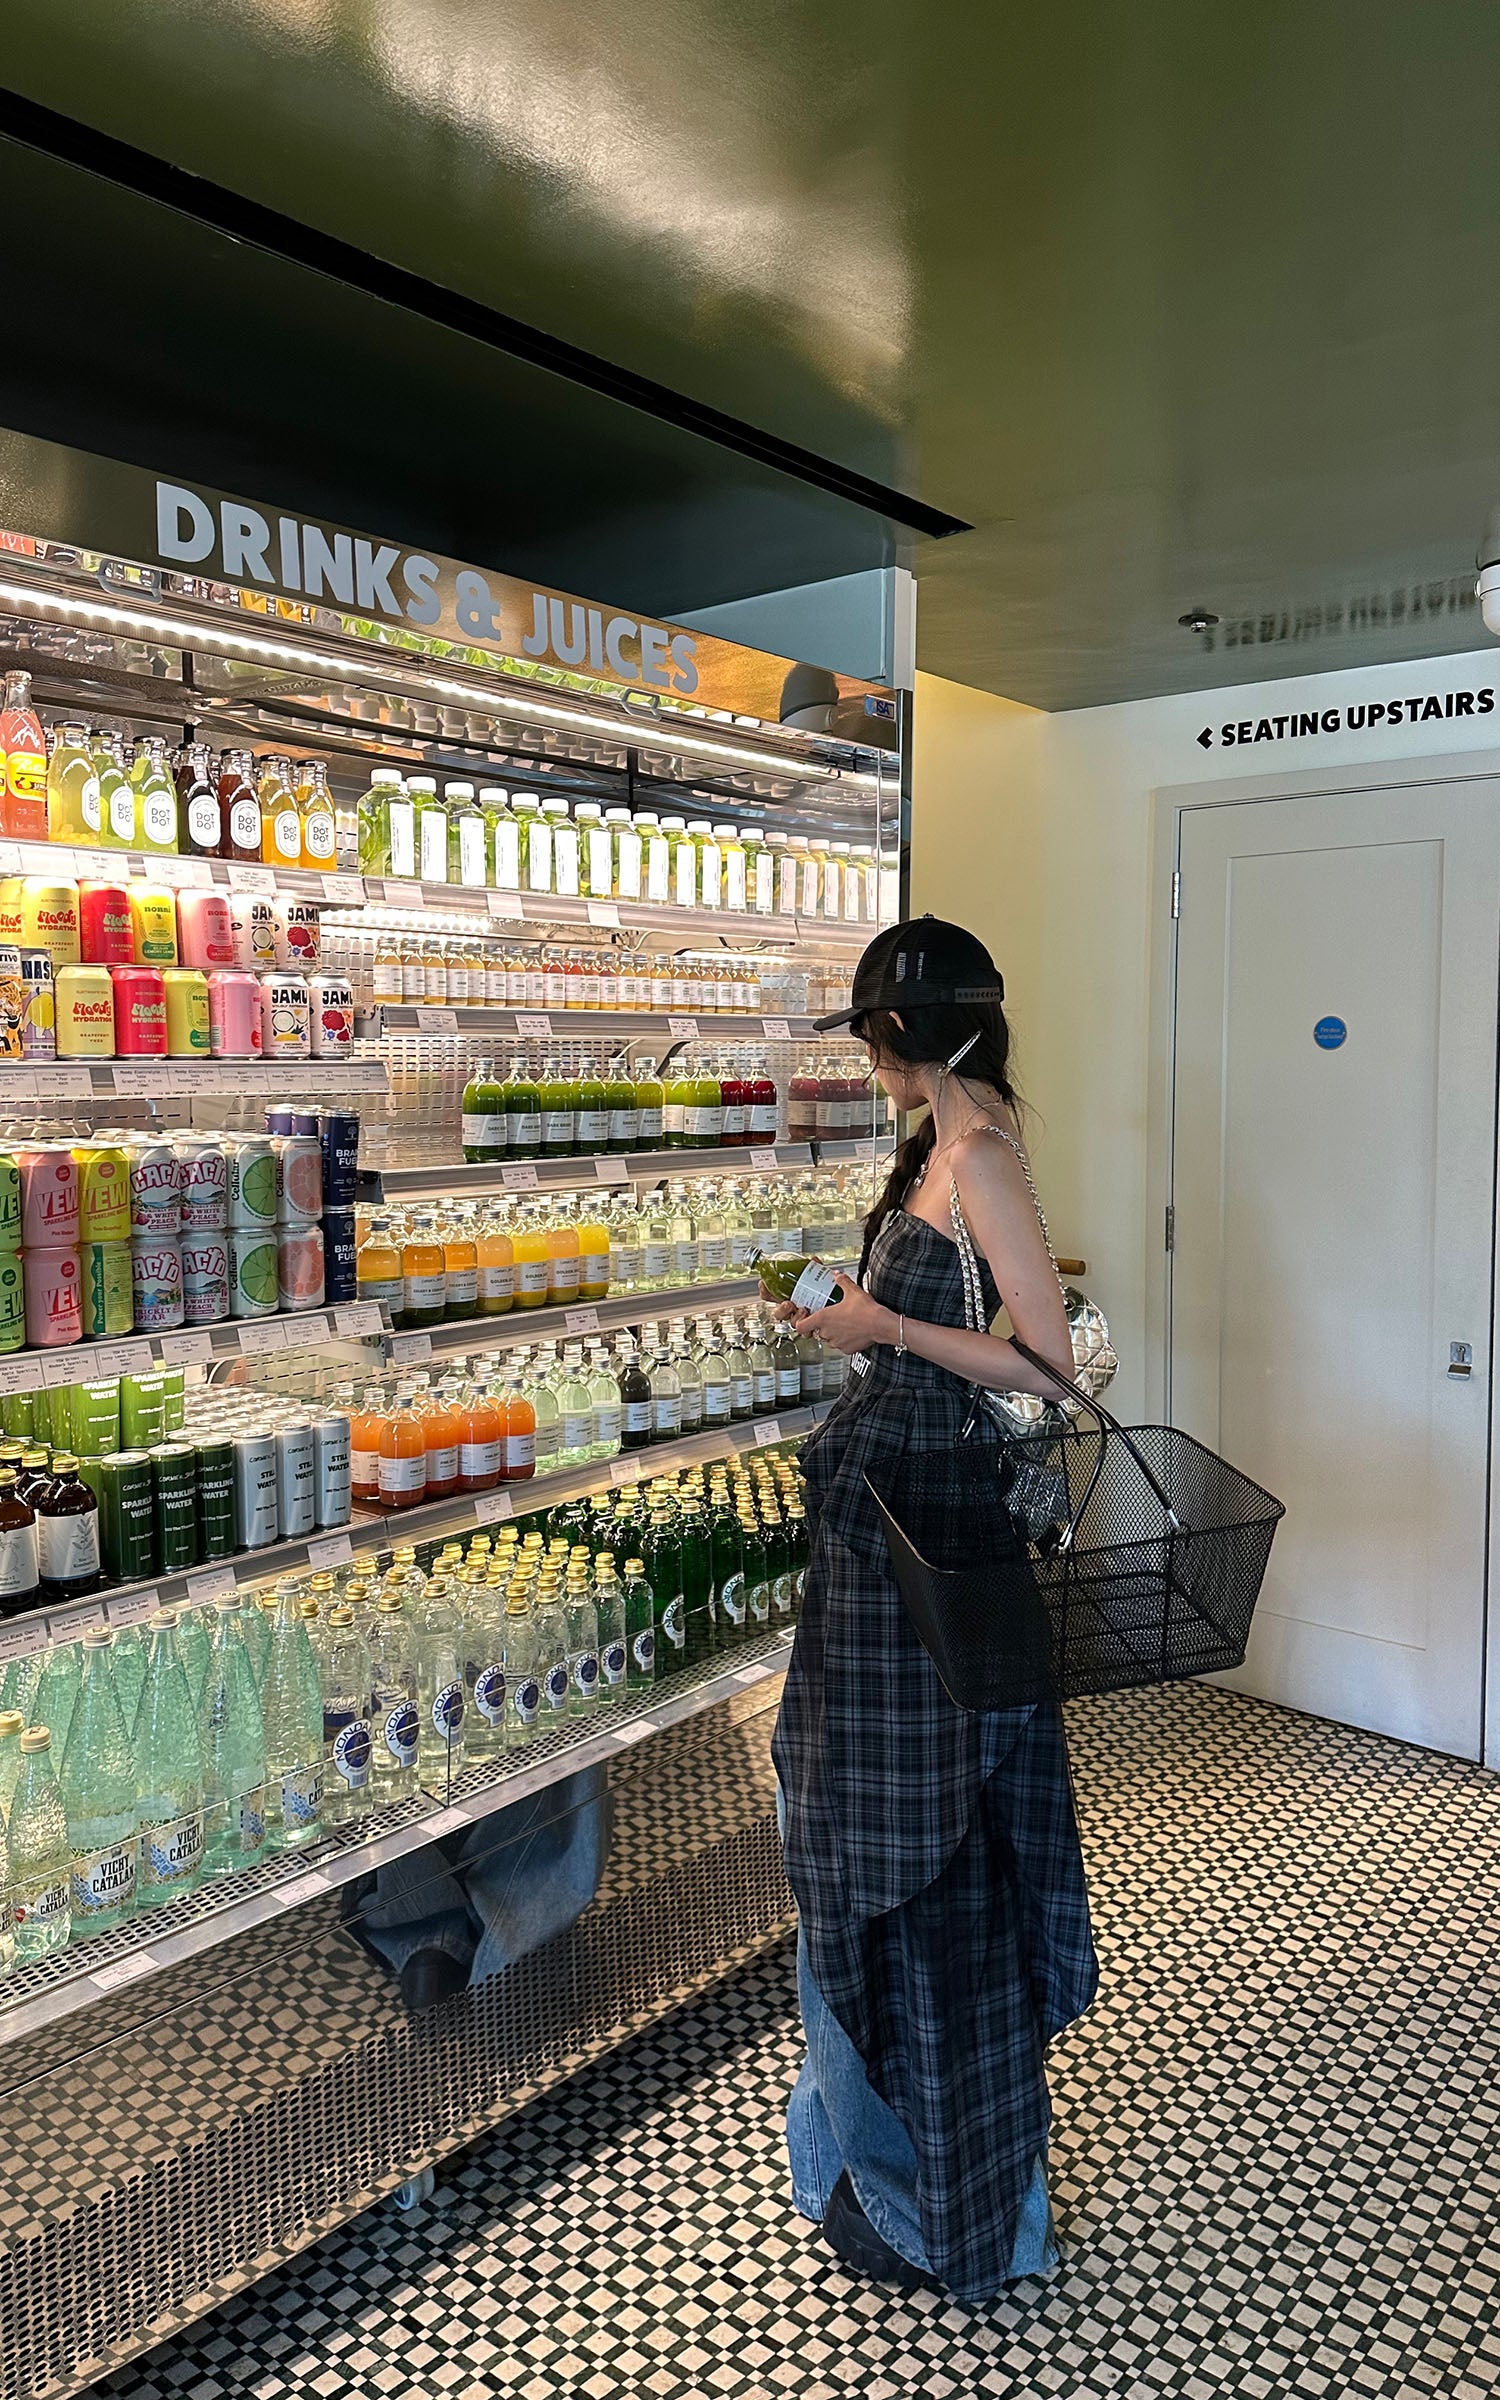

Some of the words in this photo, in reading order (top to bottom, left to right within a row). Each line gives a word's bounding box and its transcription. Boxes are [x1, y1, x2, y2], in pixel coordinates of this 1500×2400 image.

[156, 481, 441, 625] DRINKS
[456, 570, 501, 641] &
[521, 593, 699, 694] JUICES
[1221, 709, 1341, 747] SEATING
[1346, 688, 1495, 730] UPSTAIRS
[152, 808, 170, 817] DOT
[196, 812, 215, 822] DOT
[152, 816, 170, 826] DOT
[196, 821, 215, 830] DOT
[238, 815, 256, 825] DOT
[238, 823, 256, 833] DOT
[313, 826, 329, 835] DOT
[313, 833, 329, 842] DOT
[72, 1000, 111, 1016] Moody
[231, 1159, 240, 1201] Cellular
[84, 1181, 127, 1213] YEW
[230, 1248, 238, 1290] Cellular
[327, 1462, 350, 1472] WATER
[201, 1489, 229, 1500] WATER
[166, 1499, 193, 1510] WATER
[100, 1853, 130, 1877] VICHY
[92, 1864, 134, 1893] CATALAN
[45, 1886, 66, 1904] VICHY
